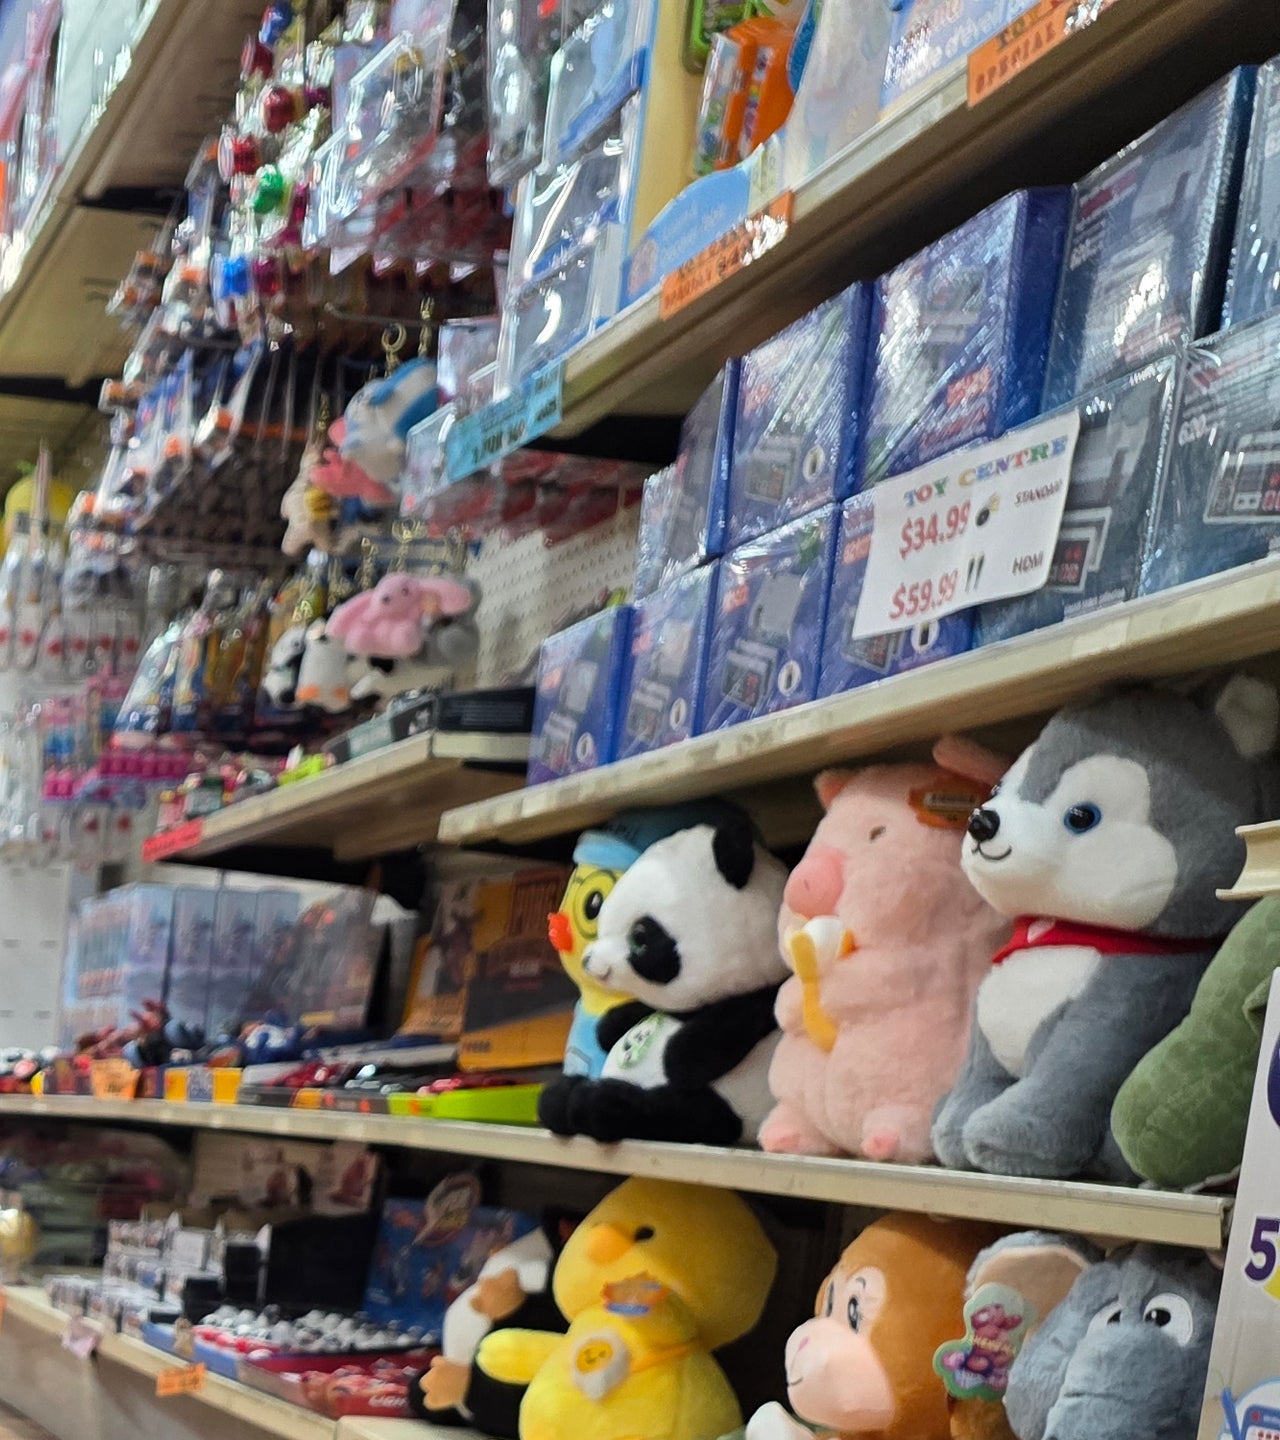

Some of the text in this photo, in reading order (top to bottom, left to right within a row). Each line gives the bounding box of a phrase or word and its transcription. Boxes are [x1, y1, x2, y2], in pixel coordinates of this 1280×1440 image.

[904, 435, 1068, 507] TOY CENTRE
[899, 502, 971, 560] $34.99
[890, 569, 959, 620] $59.99
